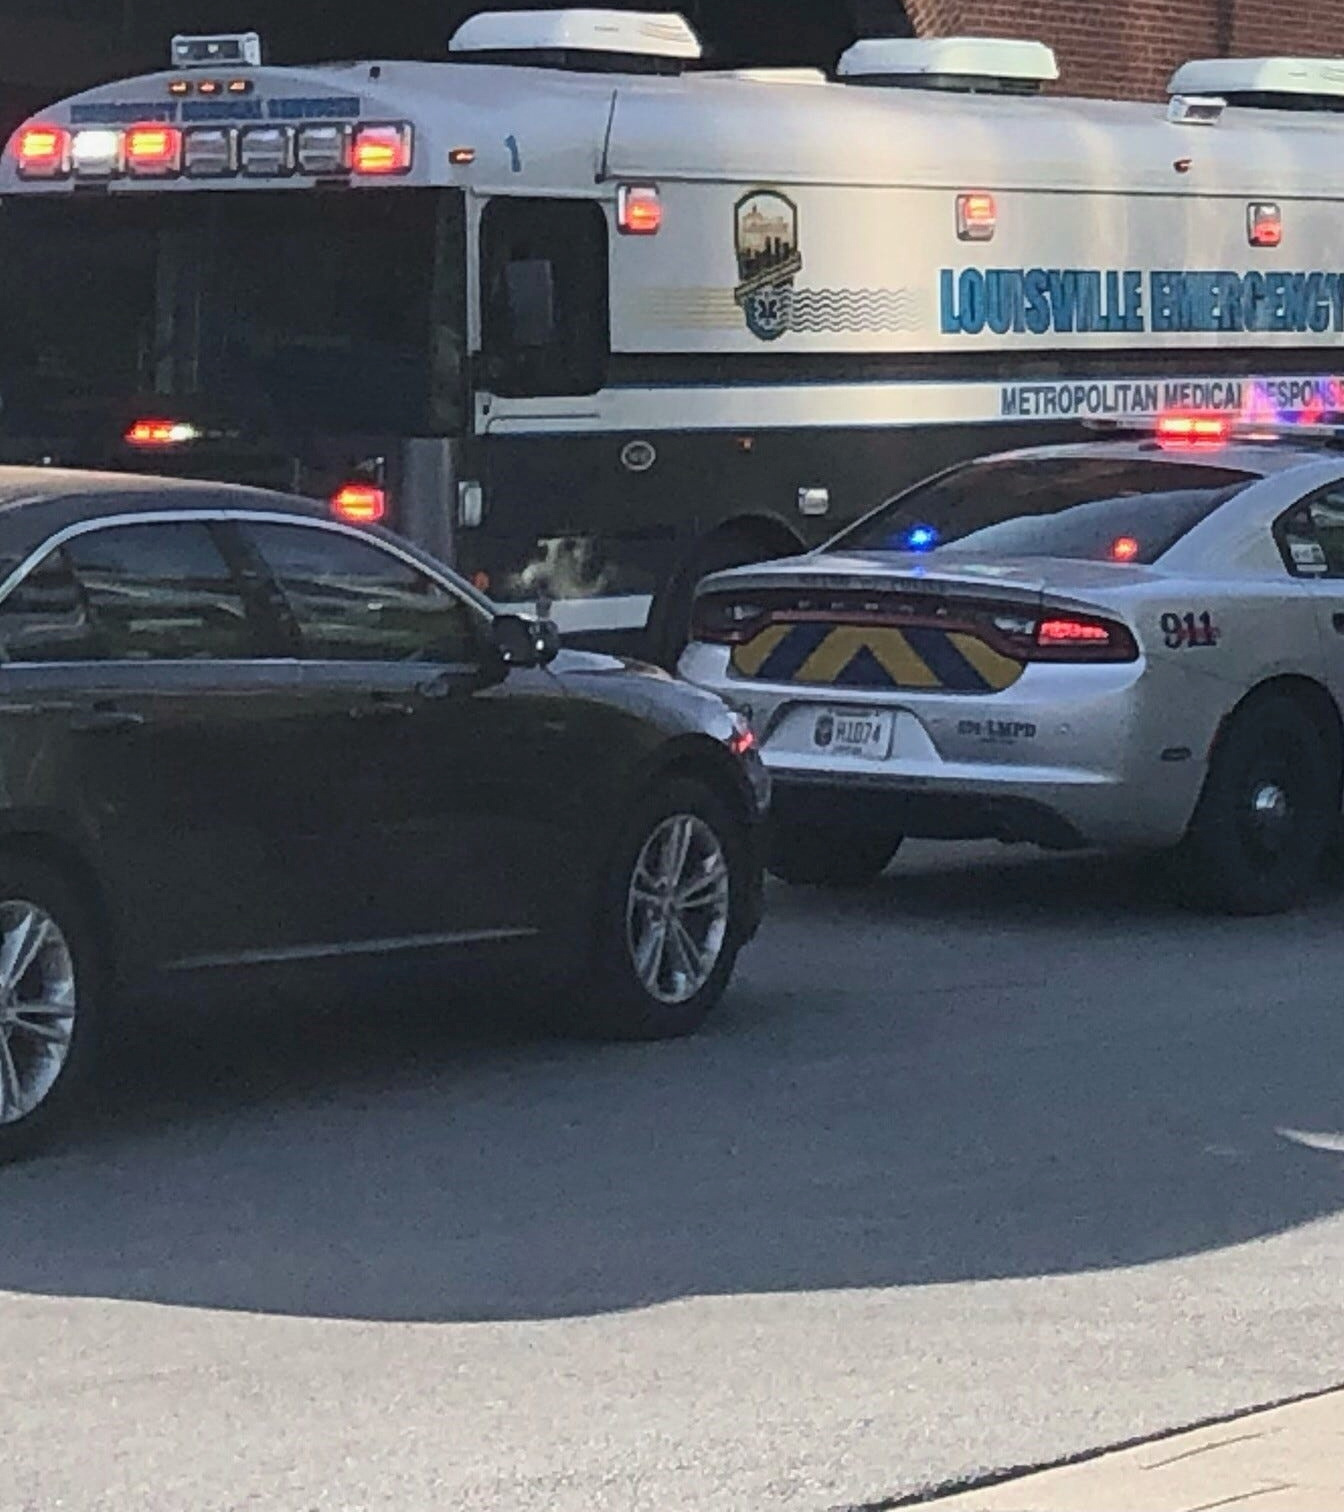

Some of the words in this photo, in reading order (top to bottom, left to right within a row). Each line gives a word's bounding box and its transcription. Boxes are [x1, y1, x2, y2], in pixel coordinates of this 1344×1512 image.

[940, 267, 1146, 334] LOUISVILLE
[1001, 386, 1159, 415] METROPOLITAN
[1164, 383, 1243, 411] MEDICAL
[1160, 612, 1219, 649] 911
